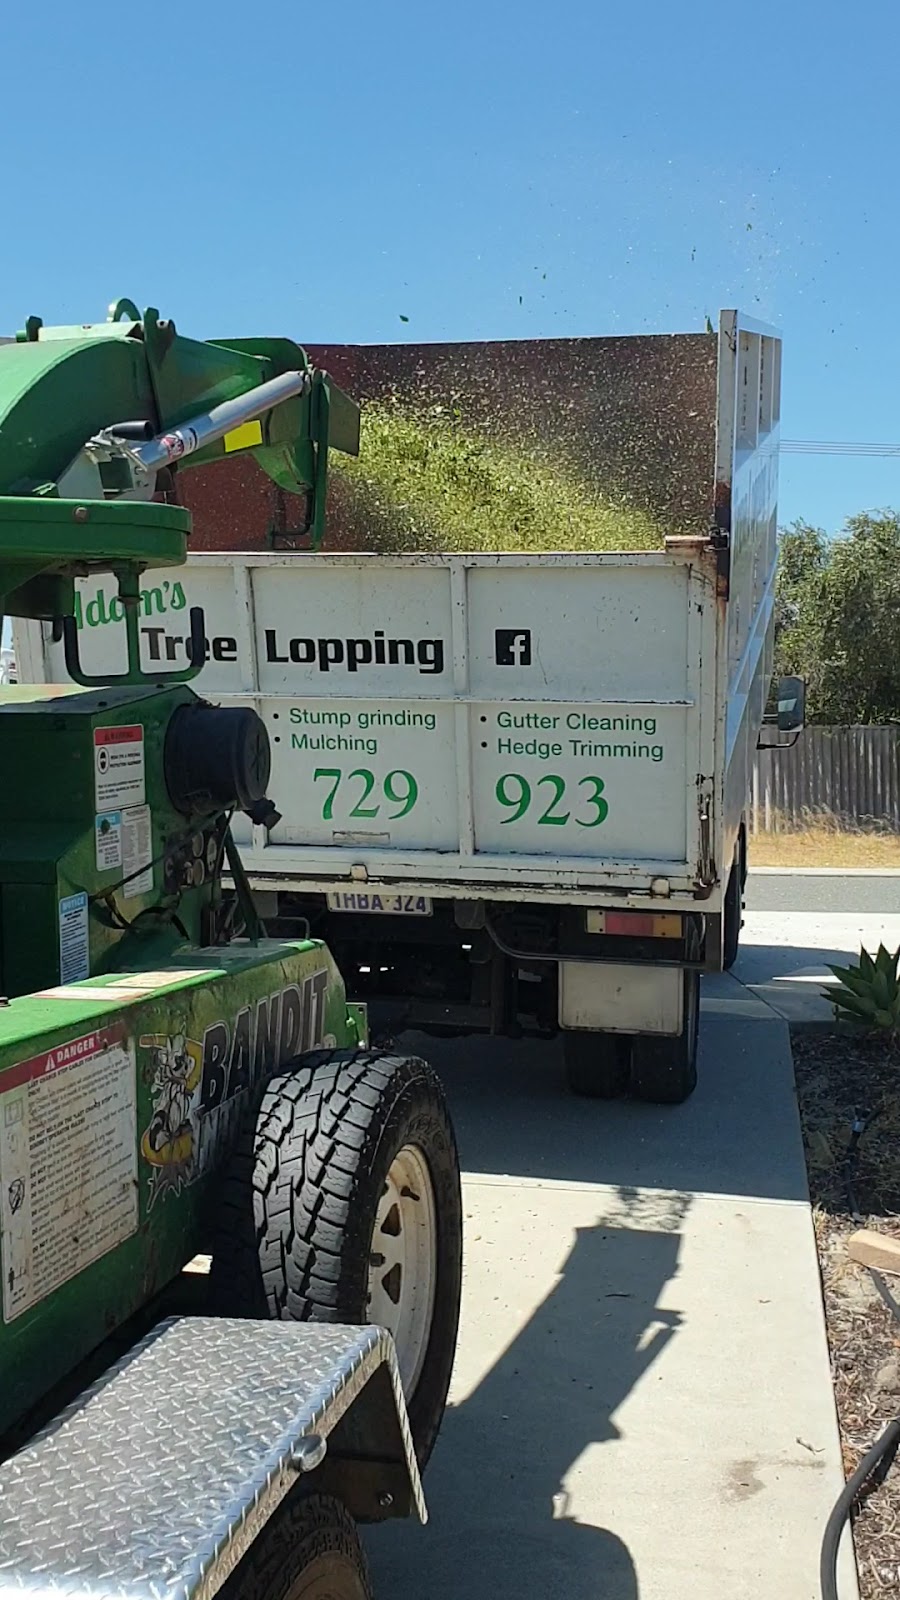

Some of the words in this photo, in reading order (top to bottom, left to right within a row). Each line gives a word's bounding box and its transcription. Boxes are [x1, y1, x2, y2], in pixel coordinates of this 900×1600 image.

[264, 629, 444, 674] Lopping
[289, 708, 351, 729] Stump
[357, 709, 436, 730] grinding
[497, 711, 560, 729] Gutter
[566, 713, 657, 736] Cleaning
[291, 733, 378, 755] Mulching
[497, 738, 562, 759] Hedge
[568, 739, 664, 762] Trimming
[313, 768, 419, 821] 729
[495, 773, 609, 827] 923
[393, 895, 426, 912] 324
[56, 1037, 95, 1063] DANGER
[200, 967, 329, 1117] BANDIT
